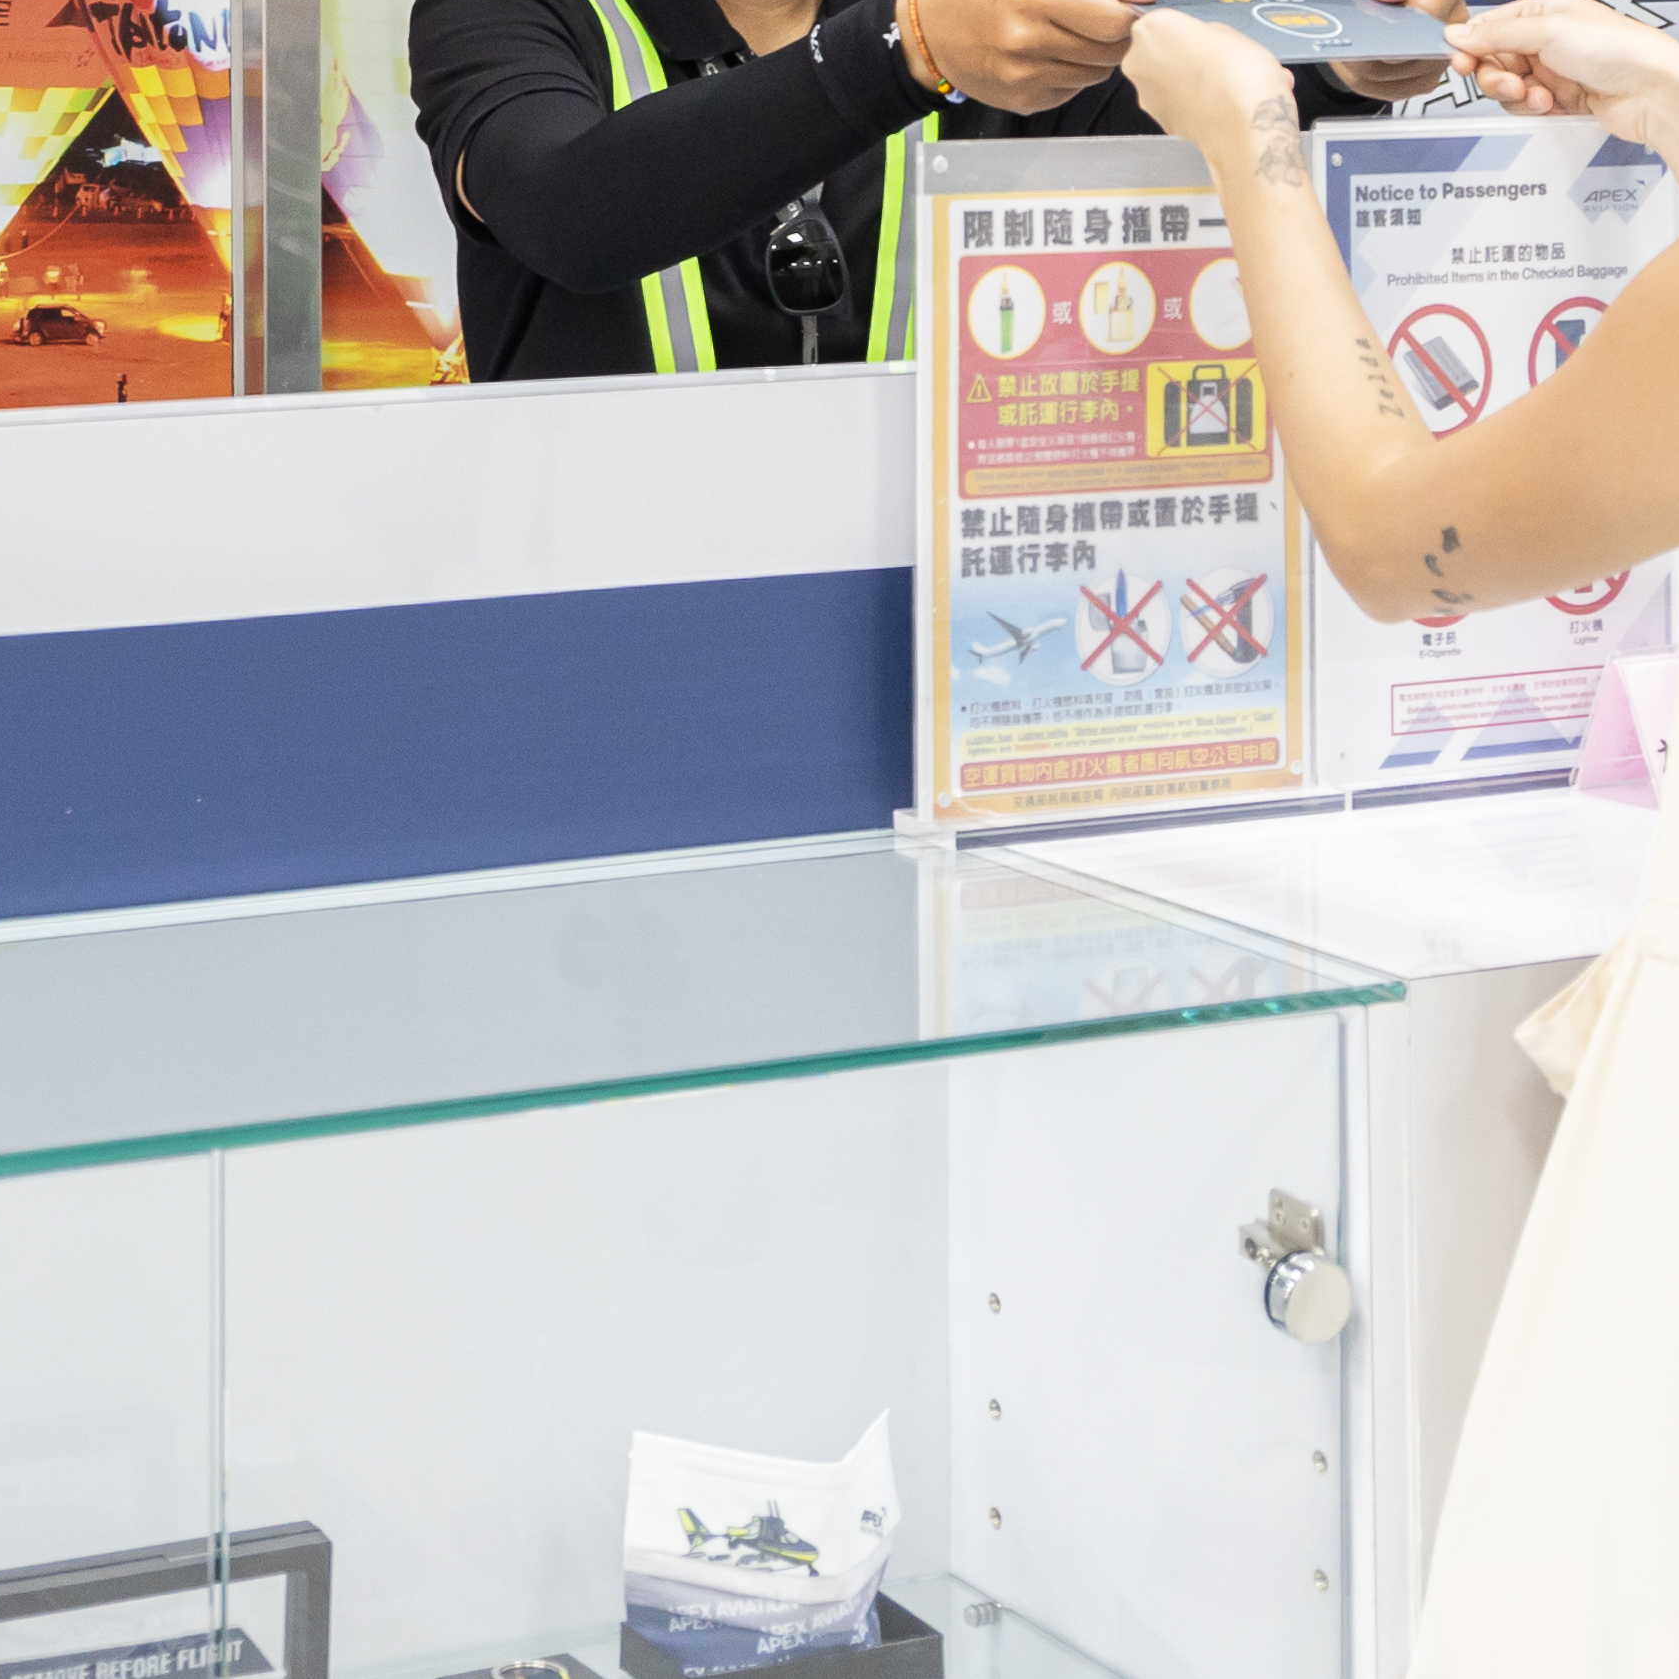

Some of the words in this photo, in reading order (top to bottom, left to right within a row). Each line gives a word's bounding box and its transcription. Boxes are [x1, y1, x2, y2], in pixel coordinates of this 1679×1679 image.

[1355, 184, 1414, 203] Notice
[1420, 184, 1438, 200] to
[1442, 181, 1547, 204] Passengers
[1583, 188, 1639, 203] APEX
[1387, 271, 1449, 287] Prohibited
[1451, 271, 1484, 284] Items
[1487, 271, 1498, 282] in
[1500, 268, 1519, 281] the
[1522, 266, 1574, 281] Checked
[1577, 264, 1628, 281] Baggage
[1052, 301, 1073, 326] 或
[1164, 297, 1184, 321] 或
